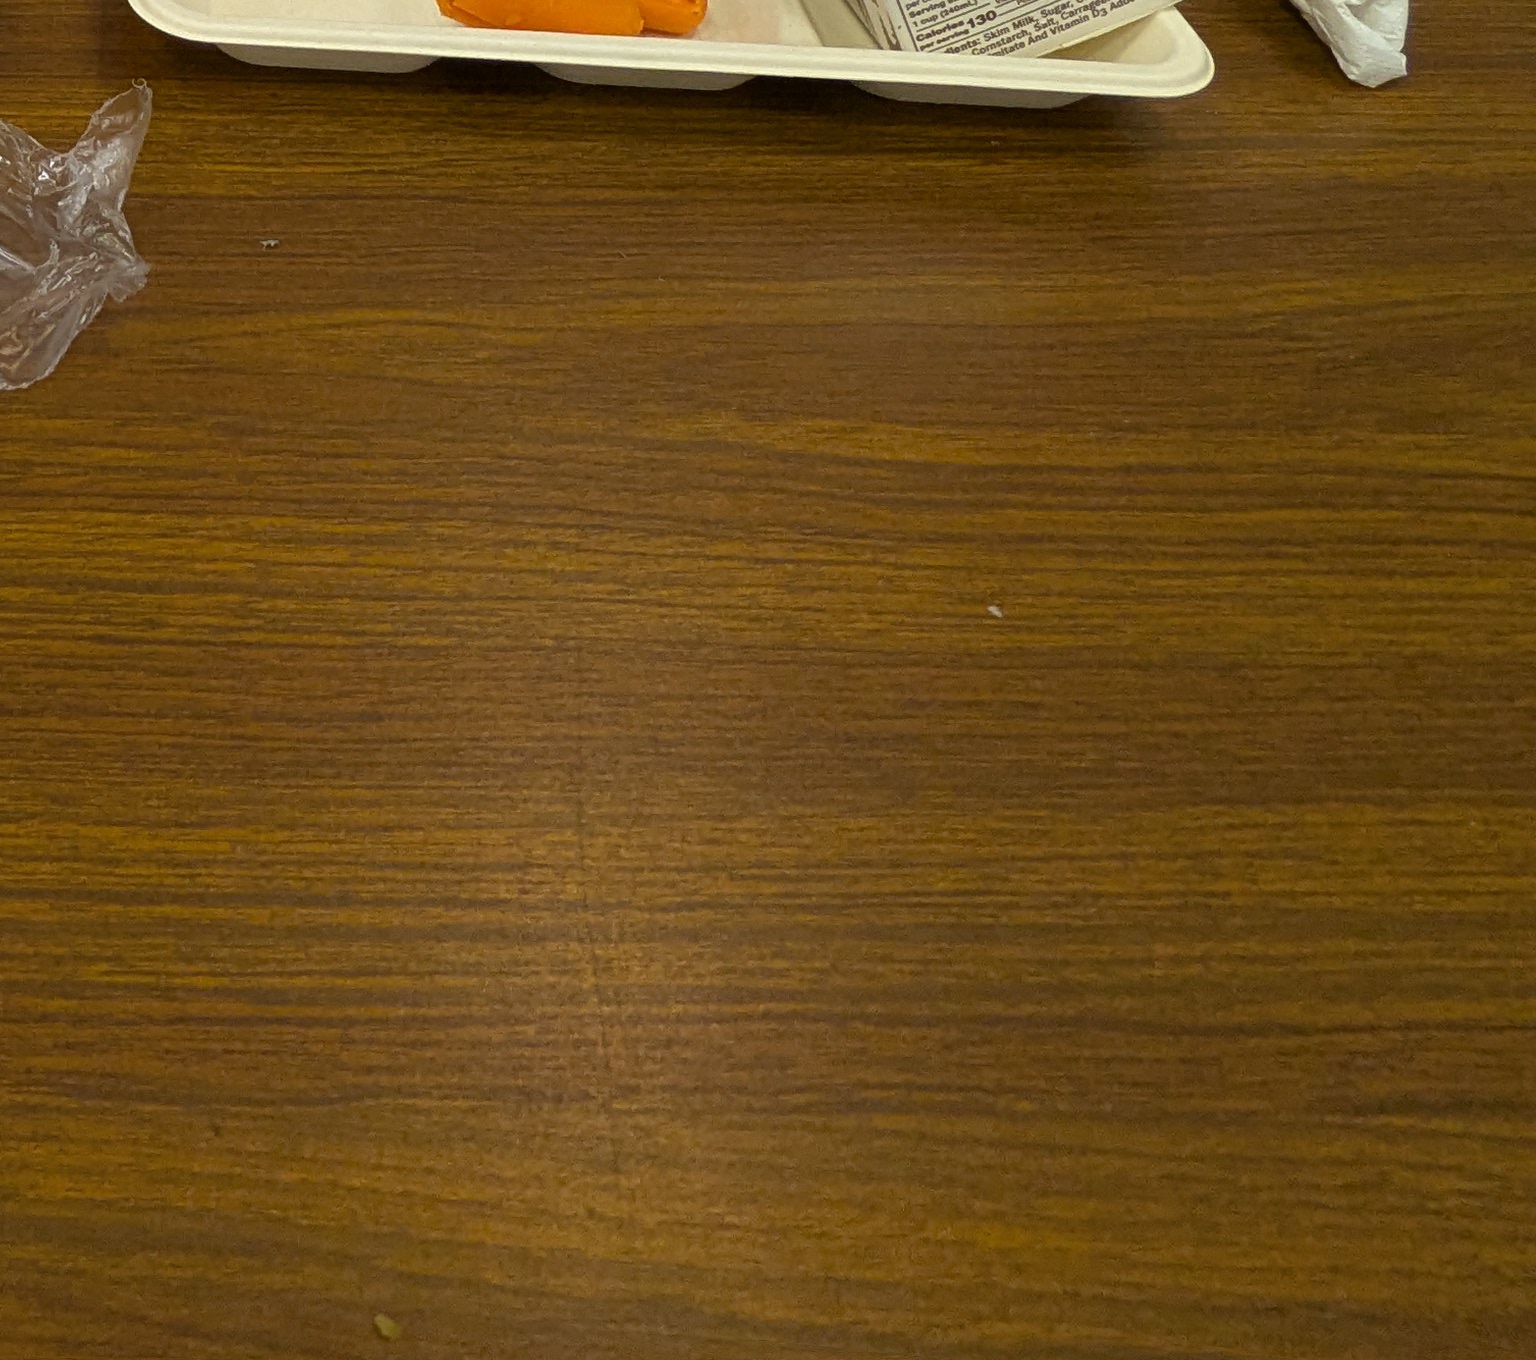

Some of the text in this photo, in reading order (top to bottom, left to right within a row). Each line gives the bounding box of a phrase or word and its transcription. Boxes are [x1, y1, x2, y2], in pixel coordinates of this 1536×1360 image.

[905, 0, 920, 11] per
[909, 1, 946, 18] Serving
[916, 10, 997, 42] Calories 130
[920, 14, 938, 26] cup
[983, 26, 1010, 42] Skim
[1012, 15, 1039, 31] Milk,
[1040, 1, 1073, 20] Sugar,
[1034, 16, 1059, 32] Salt,
[1027, 30, 1049, 46] And
[1049, 14, 1090, 34] Vitamin
